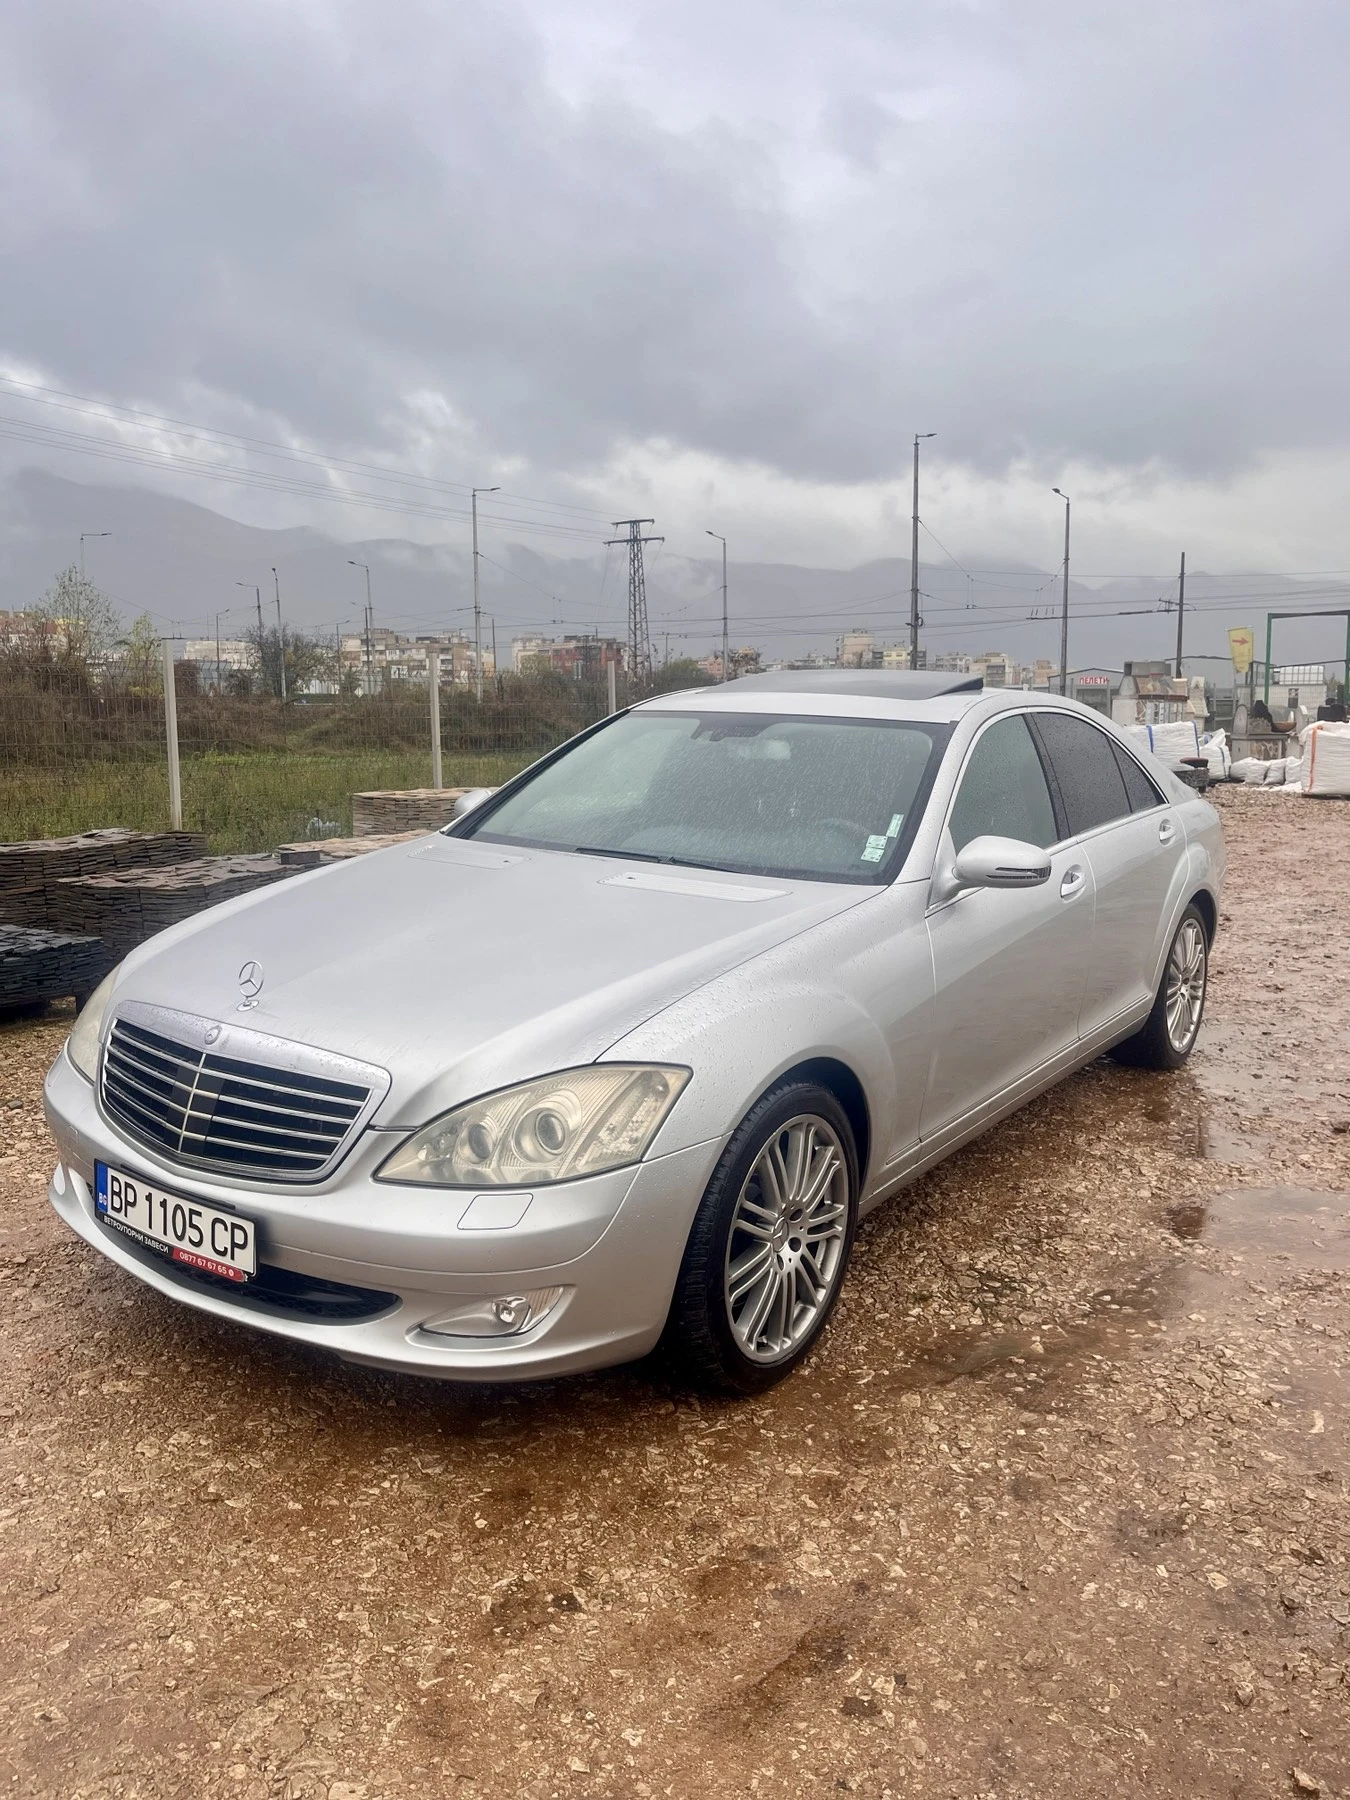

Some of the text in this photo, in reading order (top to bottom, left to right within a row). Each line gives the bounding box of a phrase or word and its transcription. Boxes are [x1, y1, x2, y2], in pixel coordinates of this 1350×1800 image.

[98, 1192, 108, 1206] BG
[103, 1215, 169, 1254] ВЕТРОУПОРНИ ЗАВЕСИ
[145, 1192, 204, 1248] 1105
[179, 1251, 227, 1275] 0877 67 67 65
